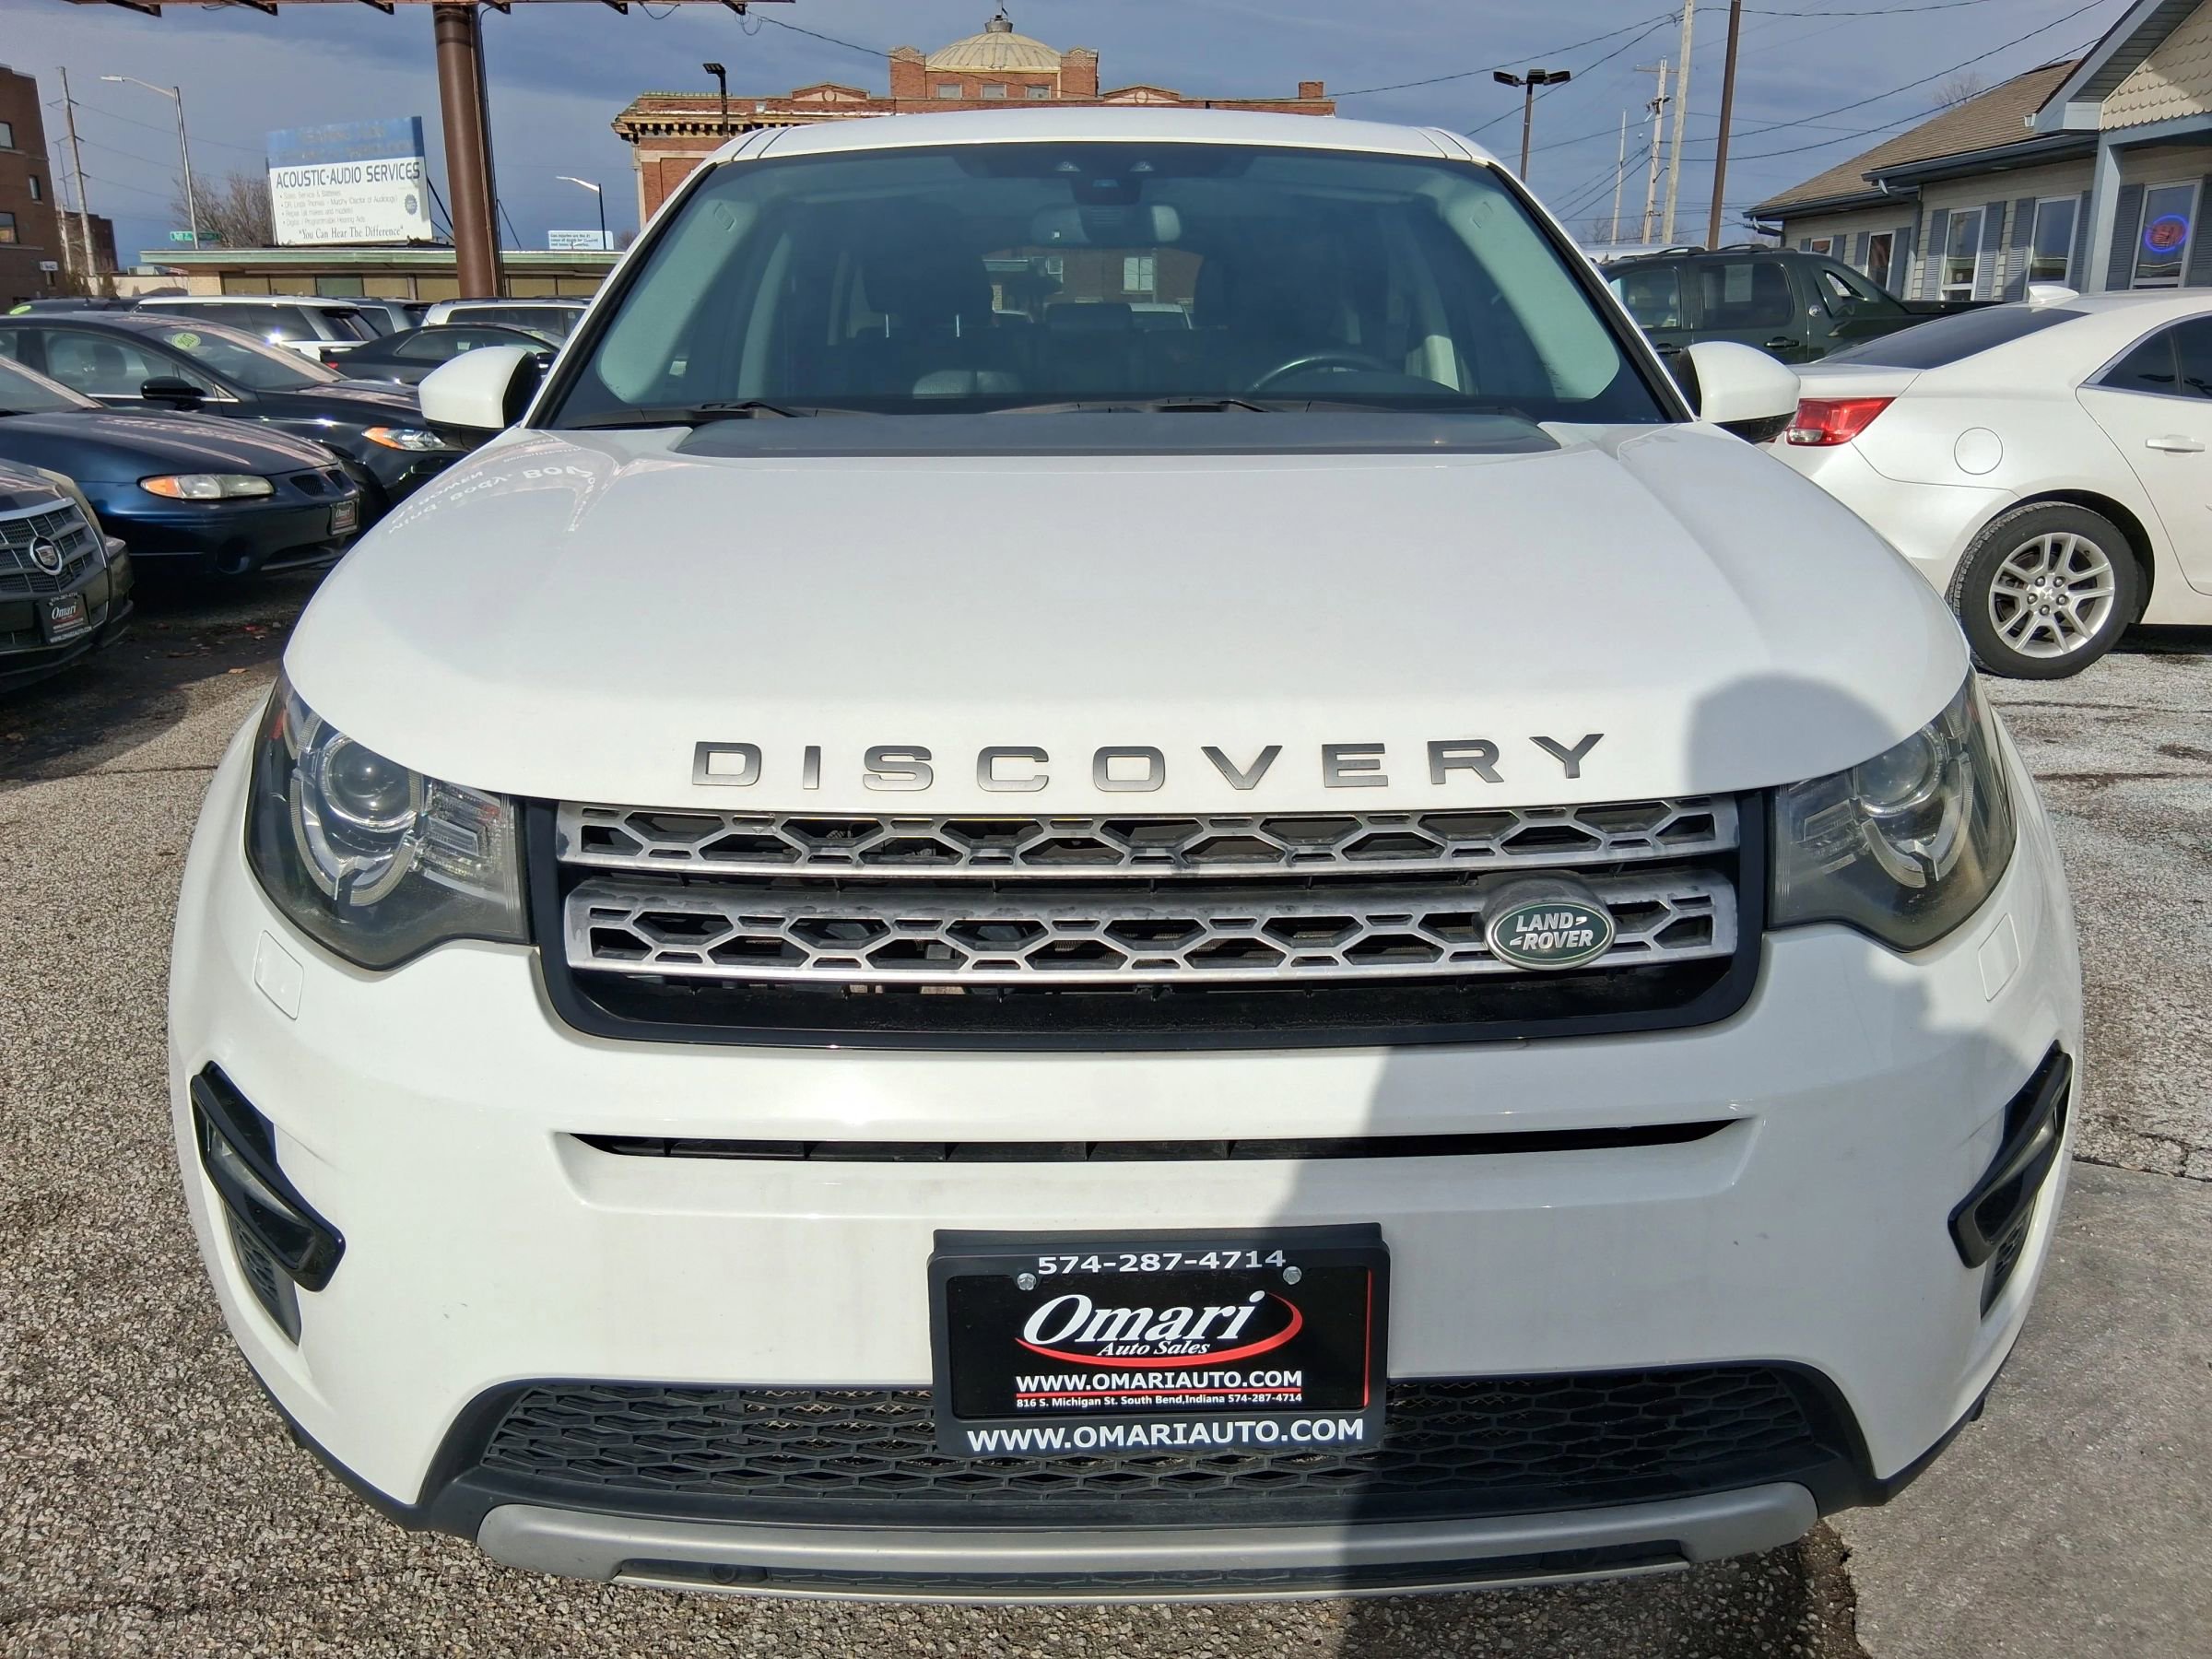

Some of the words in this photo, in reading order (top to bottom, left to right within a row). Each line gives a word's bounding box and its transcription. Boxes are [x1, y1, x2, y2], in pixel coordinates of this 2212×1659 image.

[366, 162, 420, 182] SERVICES
[315, 228, 329, 239] Can
[331, 227, 347, 238] Hear
[349, 226, 362, 237] The
[52, 602, 76, 620] Omari
[692, 734, 1605, 793] DISCOVERY
[1515, 912, 1574, 933] LAND
[1523, 929, 1594, 951] ROVER
[1038, 1250, 1287, 1276] 574-287-4714
[1023, 1290, 1266, 1346] Omari
[1097, 1340, 1150, 1357] Auto
[1152, 1339, 1211, 1357] Sales
[1016, 1370, 1302, 1393] WWW.OMARIAUTO.COM
[1016, 1398, 1037, 1407] 816
[1040, 1398, 1049, 1407] S.
[1052, 1396, 1101, 1408] Michigan
[1104, 1396, 1118, 1406] St.
[1121, 1395, 1153, 1406] South
[1155, 1394, 1225, 1406] Bend,Indiana
[1228, 1393, 1302, 1403] 574-287-4714
[966, 1418, 1364, 1452] WWW.OMARIAUTO.COM
